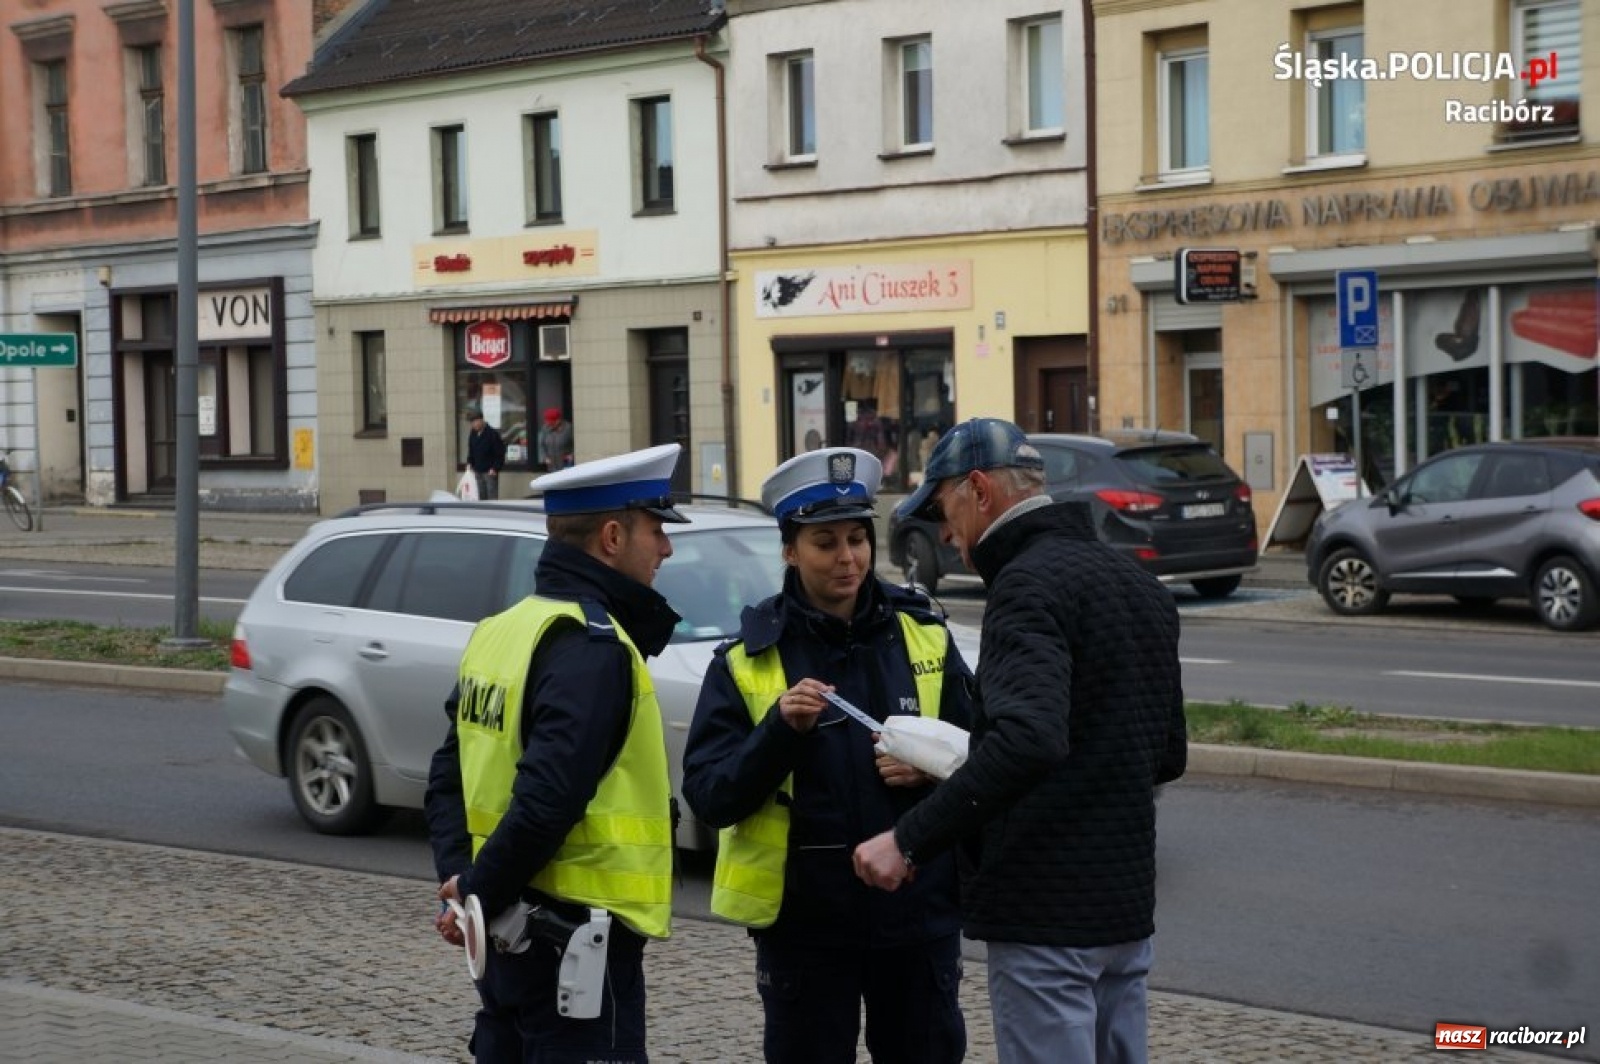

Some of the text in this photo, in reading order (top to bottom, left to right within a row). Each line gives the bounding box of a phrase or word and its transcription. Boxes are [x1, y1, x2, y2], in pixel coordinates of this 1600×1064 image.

[1303, 184, 1456, 226] NAPRAWA
[818, 270, 959, 309] Ani Ciuszek 3
[1347, 276, 1370, 326] P
[211, 293, 270, 328] VON
[0, 340, 47, 362] Opole
[470, 334, 506, 359] Berger
